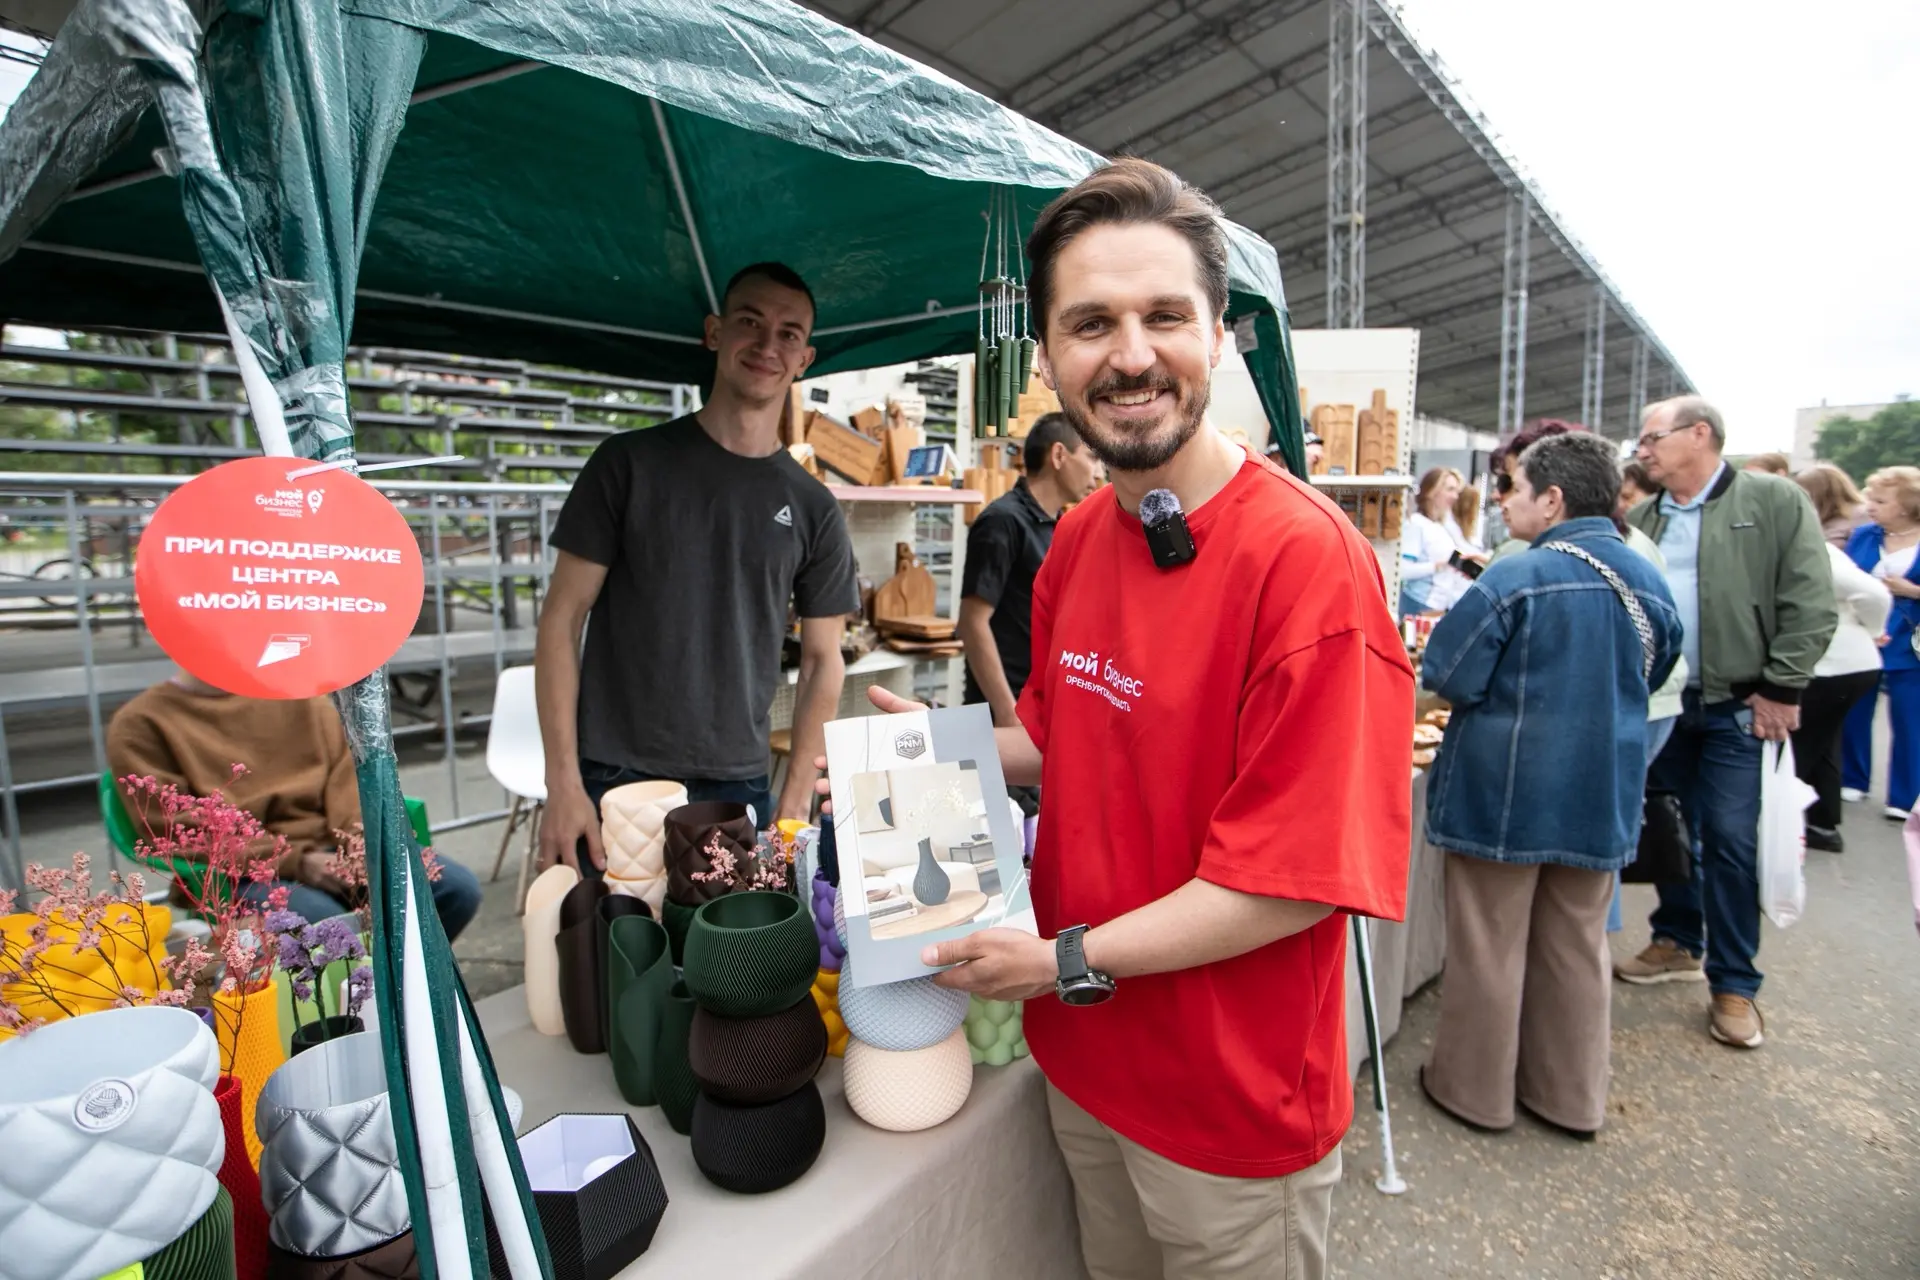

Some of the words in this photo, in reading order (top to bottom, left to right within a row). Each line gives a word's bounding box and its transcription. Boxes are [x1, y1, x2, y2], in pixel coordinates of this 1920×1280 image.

[255, 494, 303, 508] бизнес
[165, 536, 224, 554] ПРИ
[229, 539, 401, 564] ПОДДЕРЖКЕ
[232, 566, 341, 586] ЦЕНТРА
[177, 589, 261, 610] «МОЙ
[266, 595, 387, 613] БИЗНЕС»
[896, 737, 923, 749] PNM
